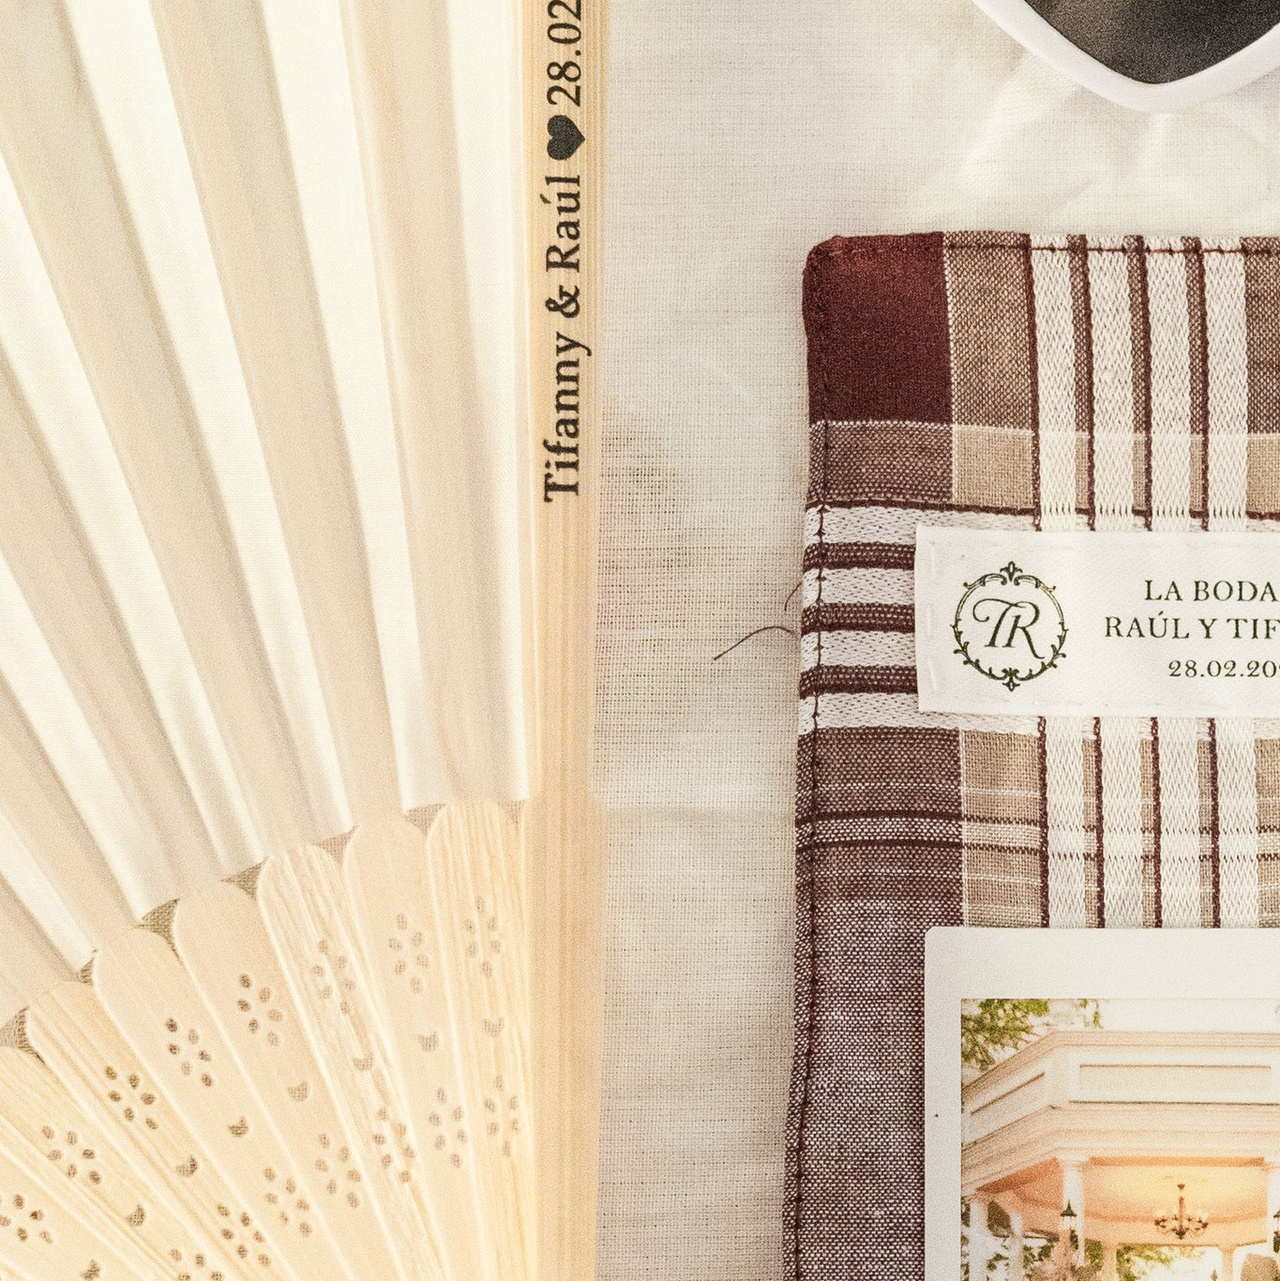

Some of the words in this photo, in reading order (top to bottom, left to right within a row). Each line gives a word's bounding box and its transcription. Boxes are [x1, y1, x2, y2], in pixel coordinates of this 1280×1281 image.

[540, 174, 581, 273] Raúl
[544, 284, 581, 319] &
[542, 331, 592, 504] Tifanny
[1143, 579, 1183, 601] LA
[1193, 580, 1278, 602] BODA
[1104, 610, 1190, 639] RAÚL
[1198, 618, 1219, 639] Y
